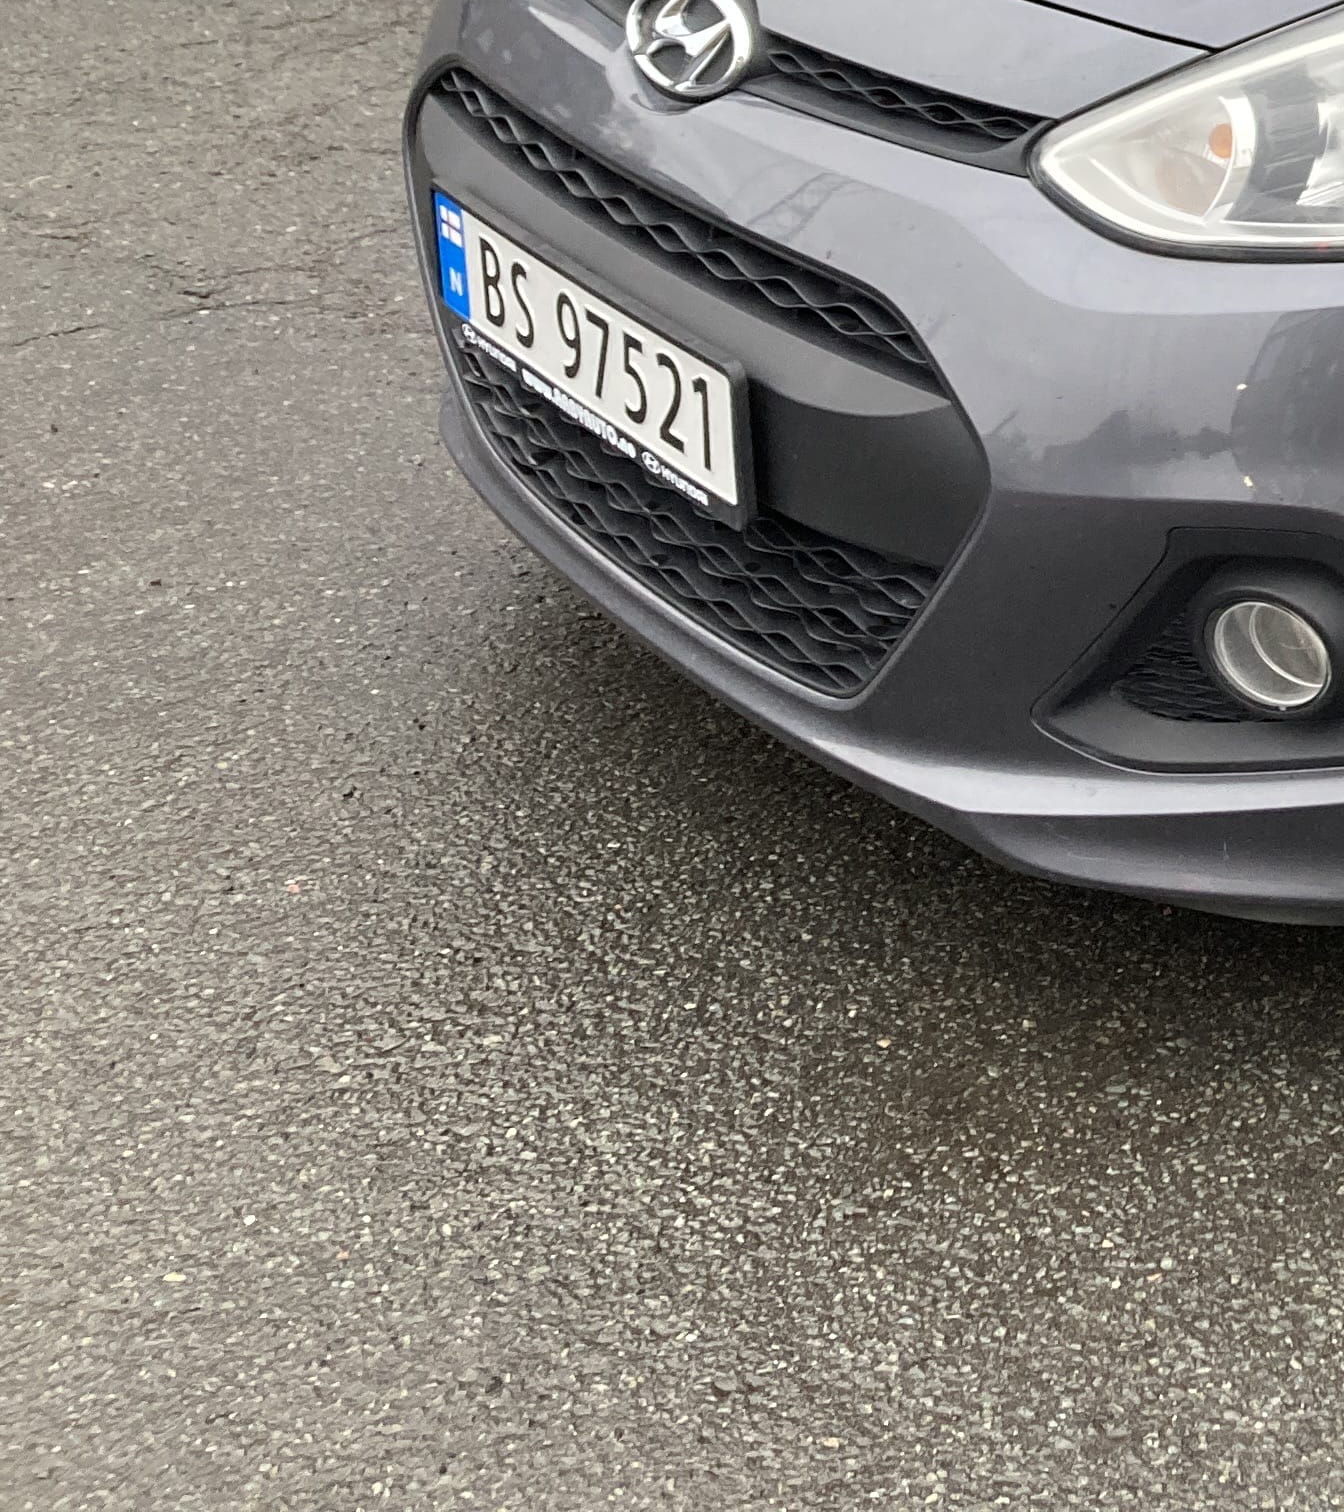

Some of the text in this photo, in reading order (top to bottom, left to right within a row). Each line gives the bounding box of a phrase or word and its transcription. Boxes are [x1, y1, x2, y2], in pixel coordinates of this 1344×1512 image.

[449, 267, 463, 296] N
[479, 235, 712, 471] BS 97521
